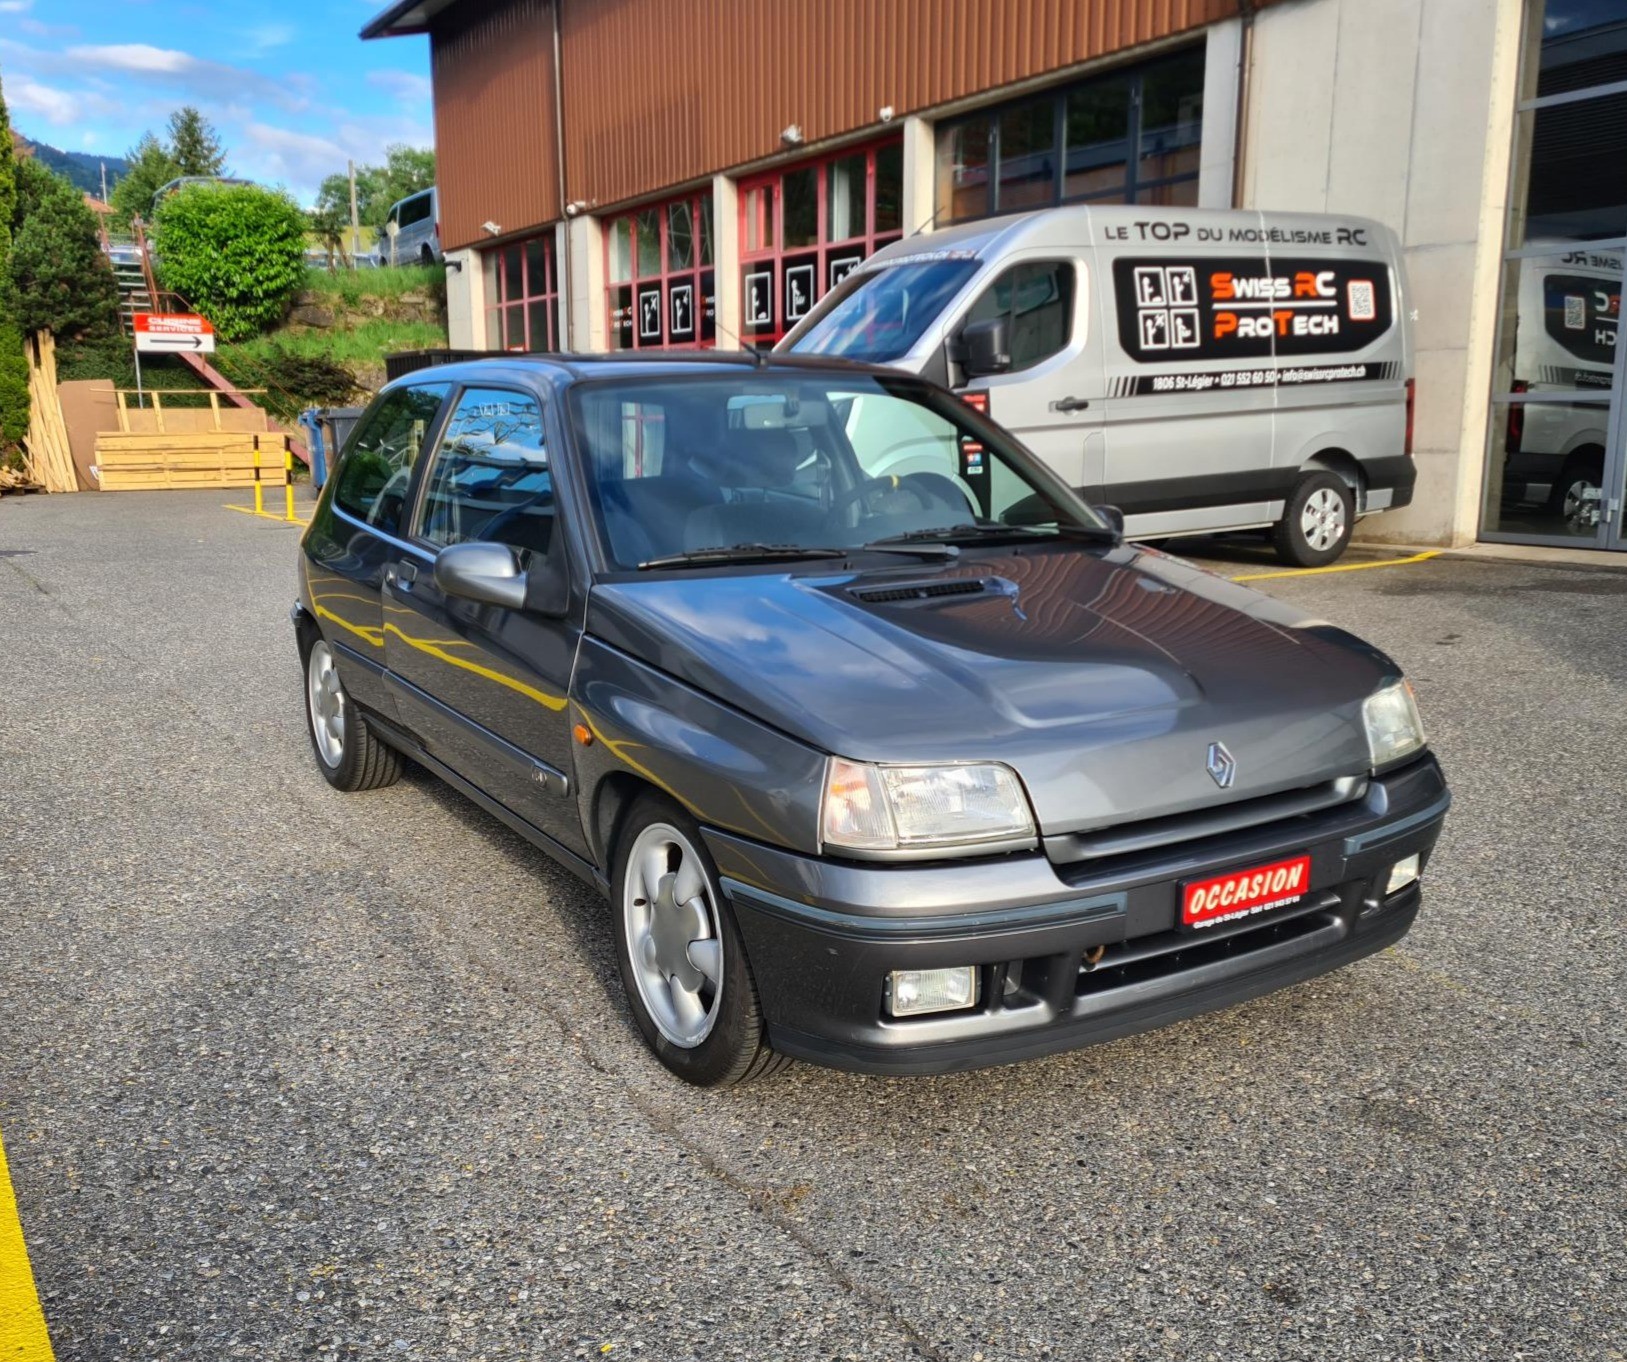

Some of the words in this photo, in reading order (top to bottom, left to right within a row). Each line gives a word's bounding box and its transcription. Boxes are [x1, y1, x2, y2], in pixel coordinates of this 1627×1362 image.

[1105, 226, 1129, 240] LE
[1134, 221, 1190, 241] TOP
[1197, 228, 1223, 242] DU
[1229, 227, 1332, 244] MODÉLISME
[1336, 228, 1367, 246] RC
[1294, 271, 1337, 297] RC
[1153, 376, 1174, 391] 1806
[1220, 372, 1236, 387] 021
[1236, 371, 1251, 386] 552
[1252, 370, 1264, 385] 60
[1264, 370, 1275, 384] 50
[1189, 863, 1304, 914] OCCASION
